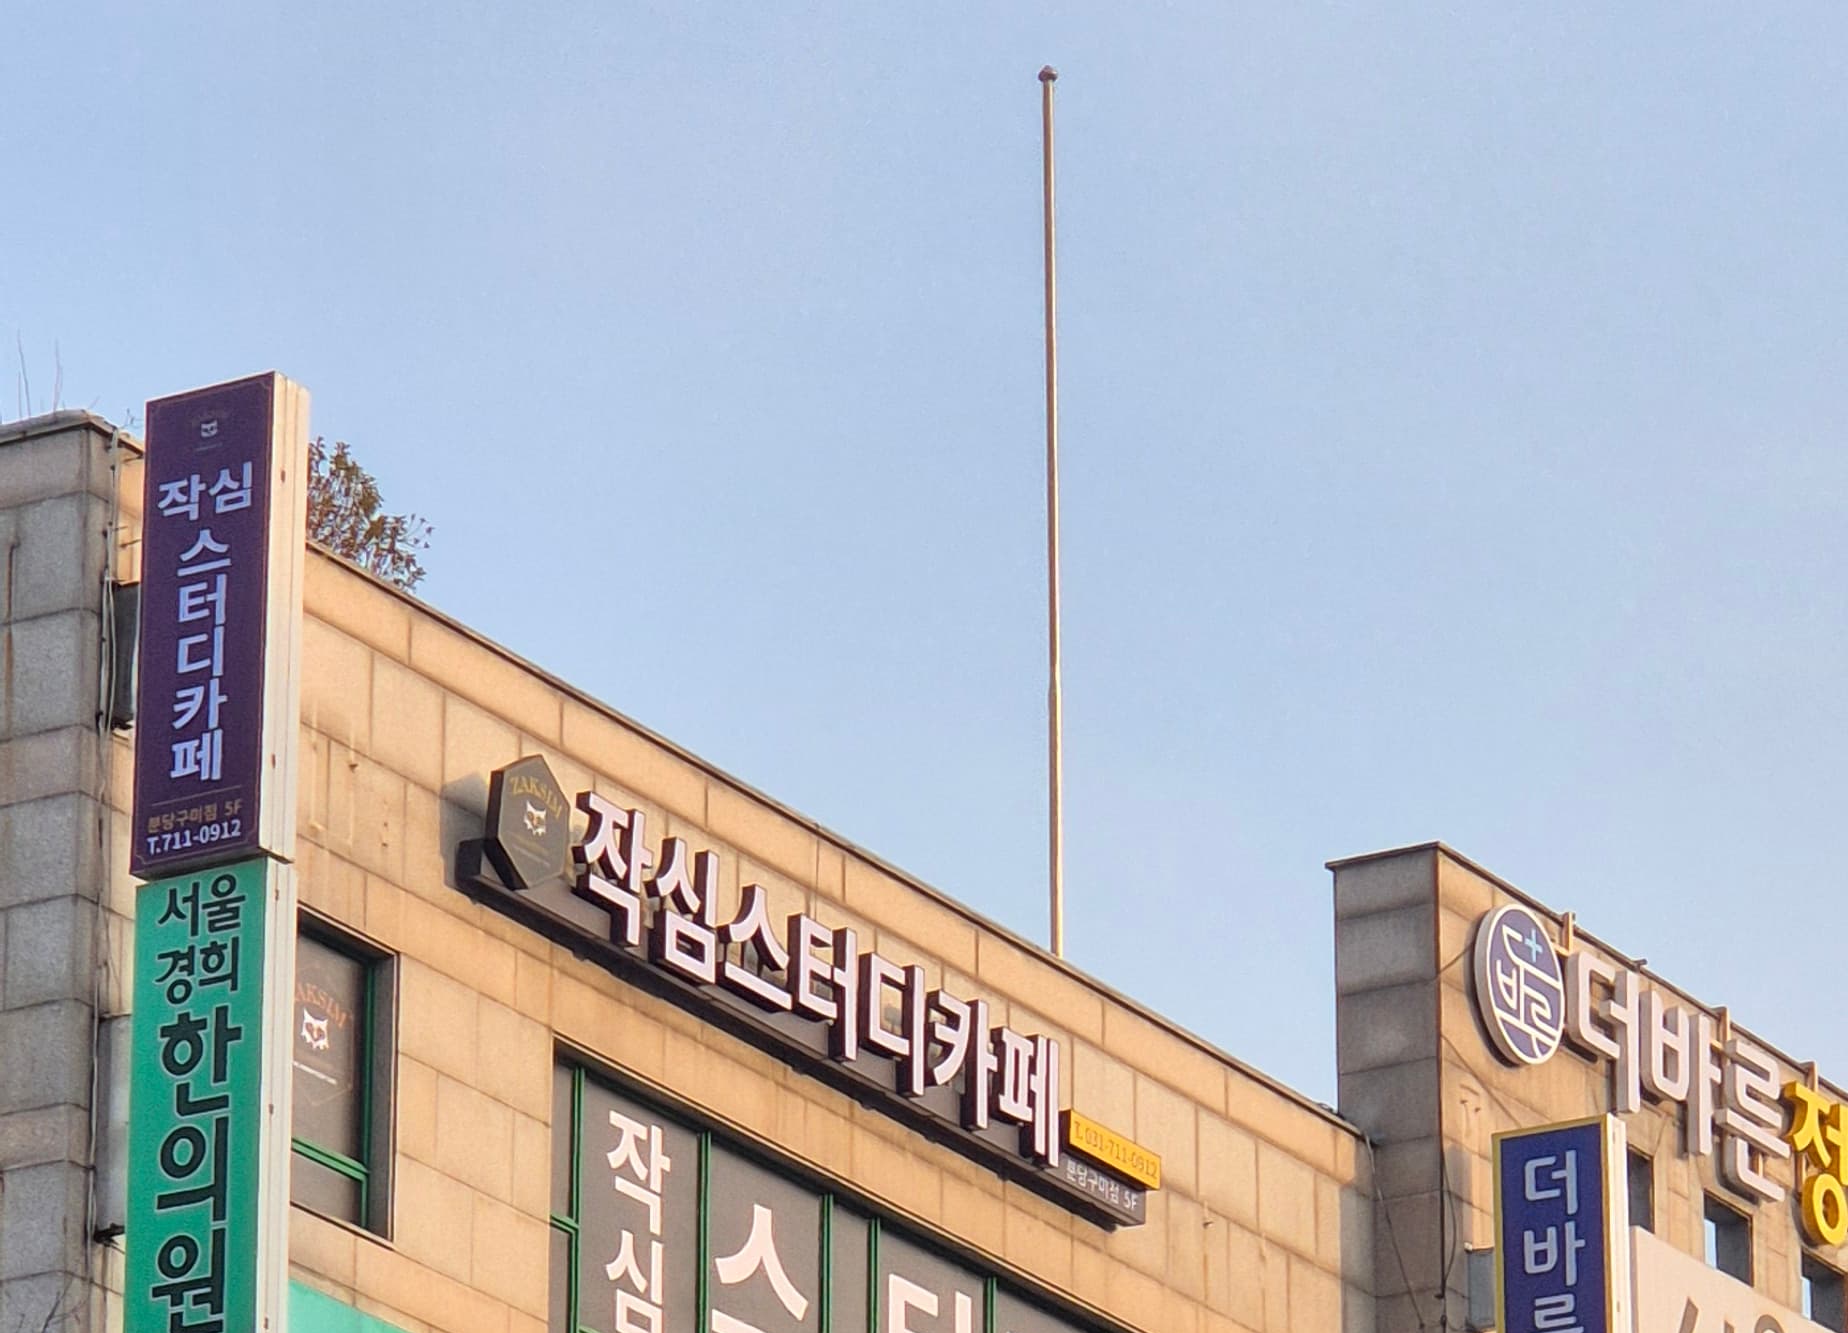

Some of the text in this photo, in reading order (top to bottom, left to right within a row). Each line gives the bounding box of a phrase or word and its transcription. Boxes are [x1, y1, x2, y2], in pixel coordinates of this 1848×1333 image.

[157, 460, 254, 519] 작심
[169, 528, 232, 782] 스터디카페
[147, 818, 242, 856] T.711-0912
[156, 872, 247, 938] 서울
[154, 936, 240, 1006] 경희
[572, 789, 1061, 1169] 작심스터디카페
